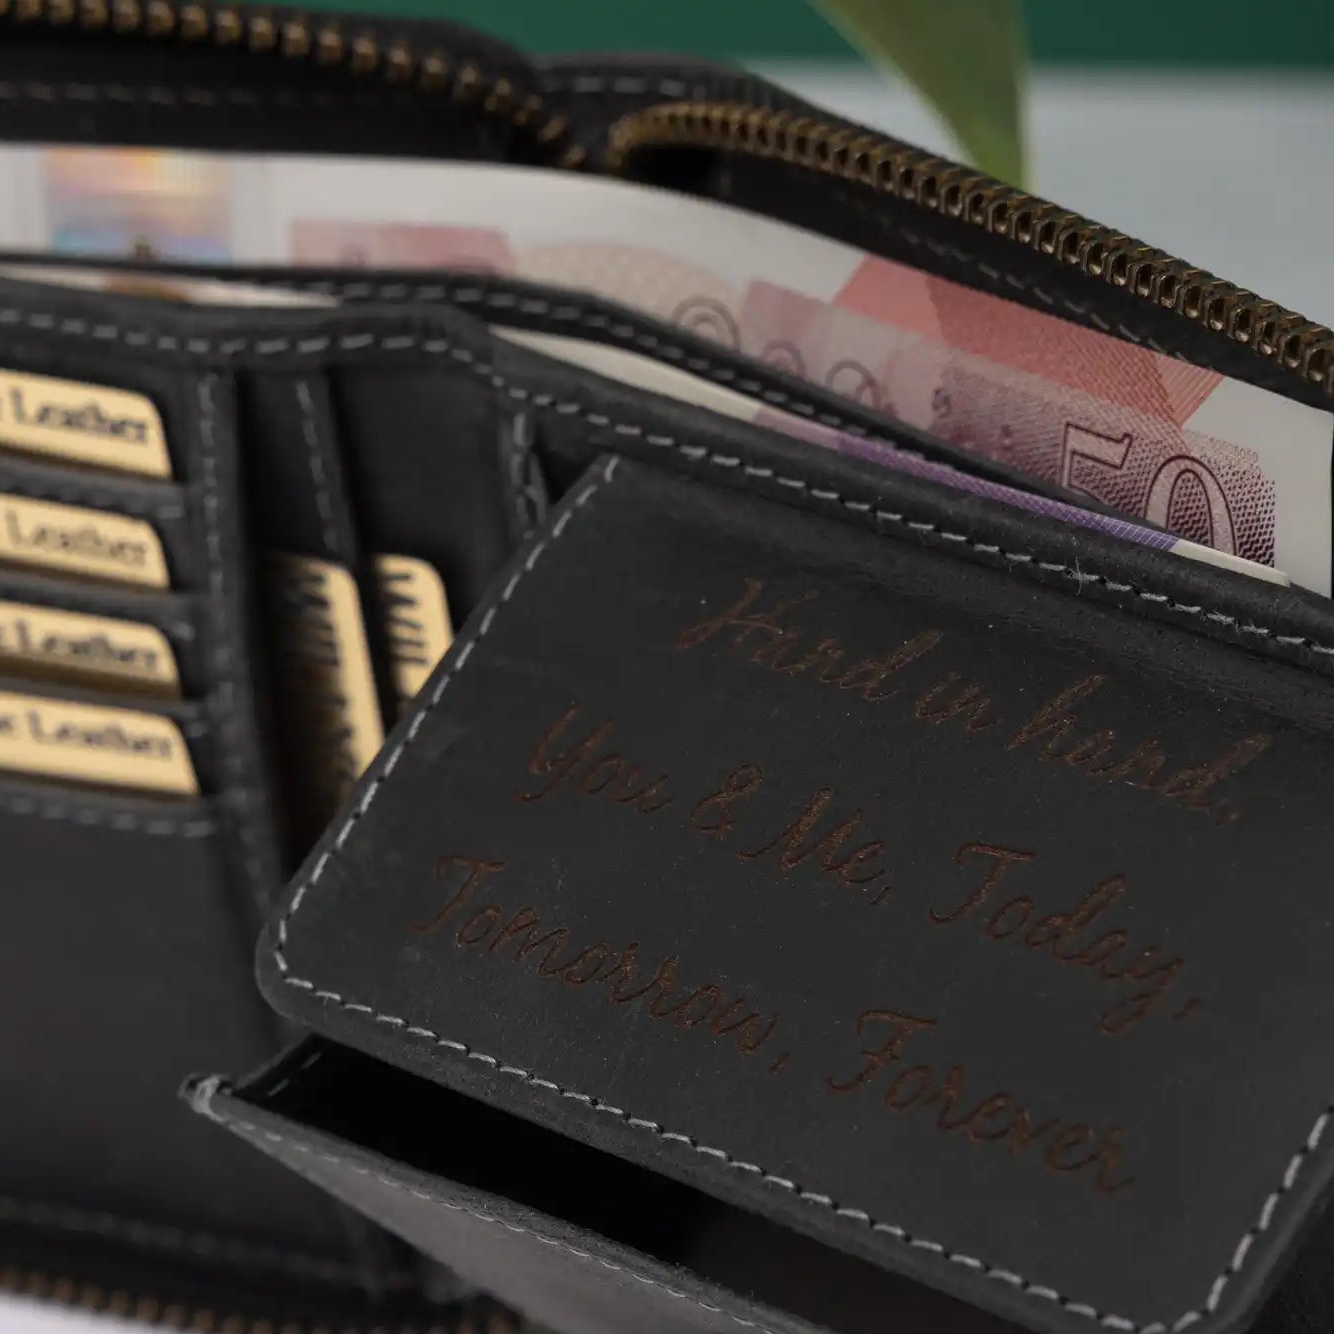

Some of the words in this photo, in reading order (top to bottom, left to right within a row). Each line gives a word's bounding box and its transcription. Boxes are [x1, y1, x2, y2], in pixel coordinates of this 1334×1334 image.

[10, 387, 151, 444] Leather
[6, 509, 147, 567] Leather
[17, 619, 158, 670] Leather
[675, 576, 944, 702] Hand
[915, 670, 1001, 732] in
[1003, 673, 1273, 828] hand,
[28, 708, 173, 758] Leather
[515, 705, 675, 814] You
[689, 762, 763, 840] &
[736, 785, 893, 905] Me,
[928, 842, 1201, 1036] Today,
[407, 852, 791, 1074] Tomorrow,
[826, 1008, 1137, 1196] Forever
